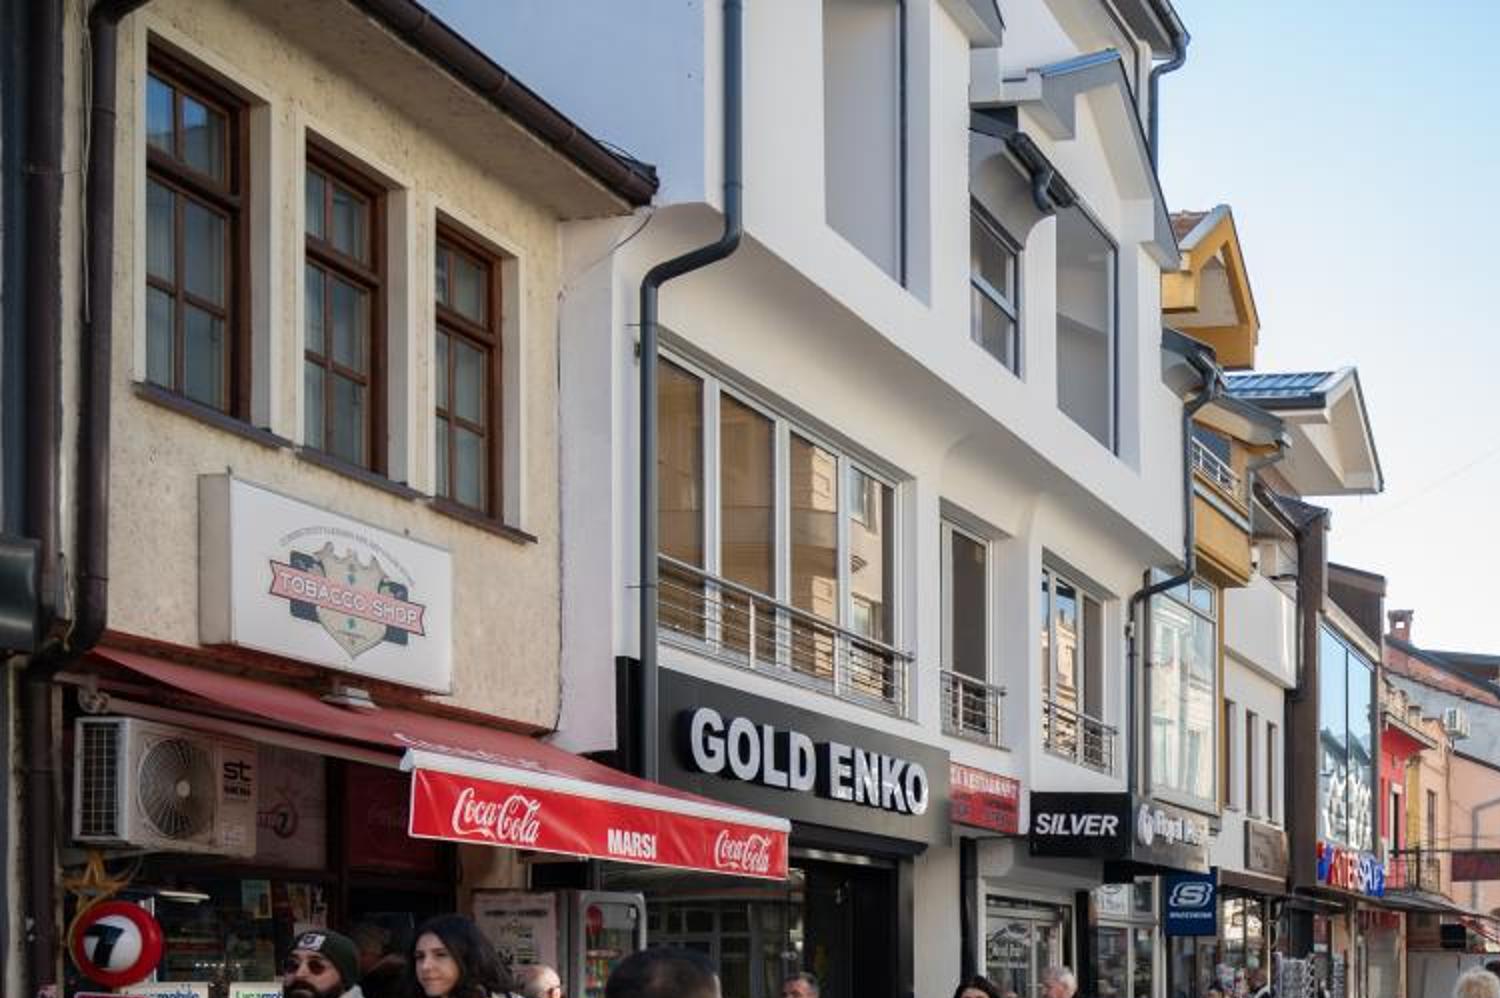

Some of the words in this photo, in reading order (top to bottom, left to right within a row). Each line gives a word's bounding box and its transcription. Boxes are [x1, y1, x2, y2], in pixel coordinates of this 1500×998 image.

[280, 573, 367, 611] TOBACCO
[372, 599, 418, 625] SHOP
[690, 706, 817, 792] GOLD
[828, 740, 929, 816] ENKO
[451, 786, 541, 844] Coca-Cola
[1035, 813, 1119, 837] SILVER
[606, 829, 658, 860] MARSI
[713, 829, 772, 874] Coca-Cola
[85, 923, 125, 968] 7
